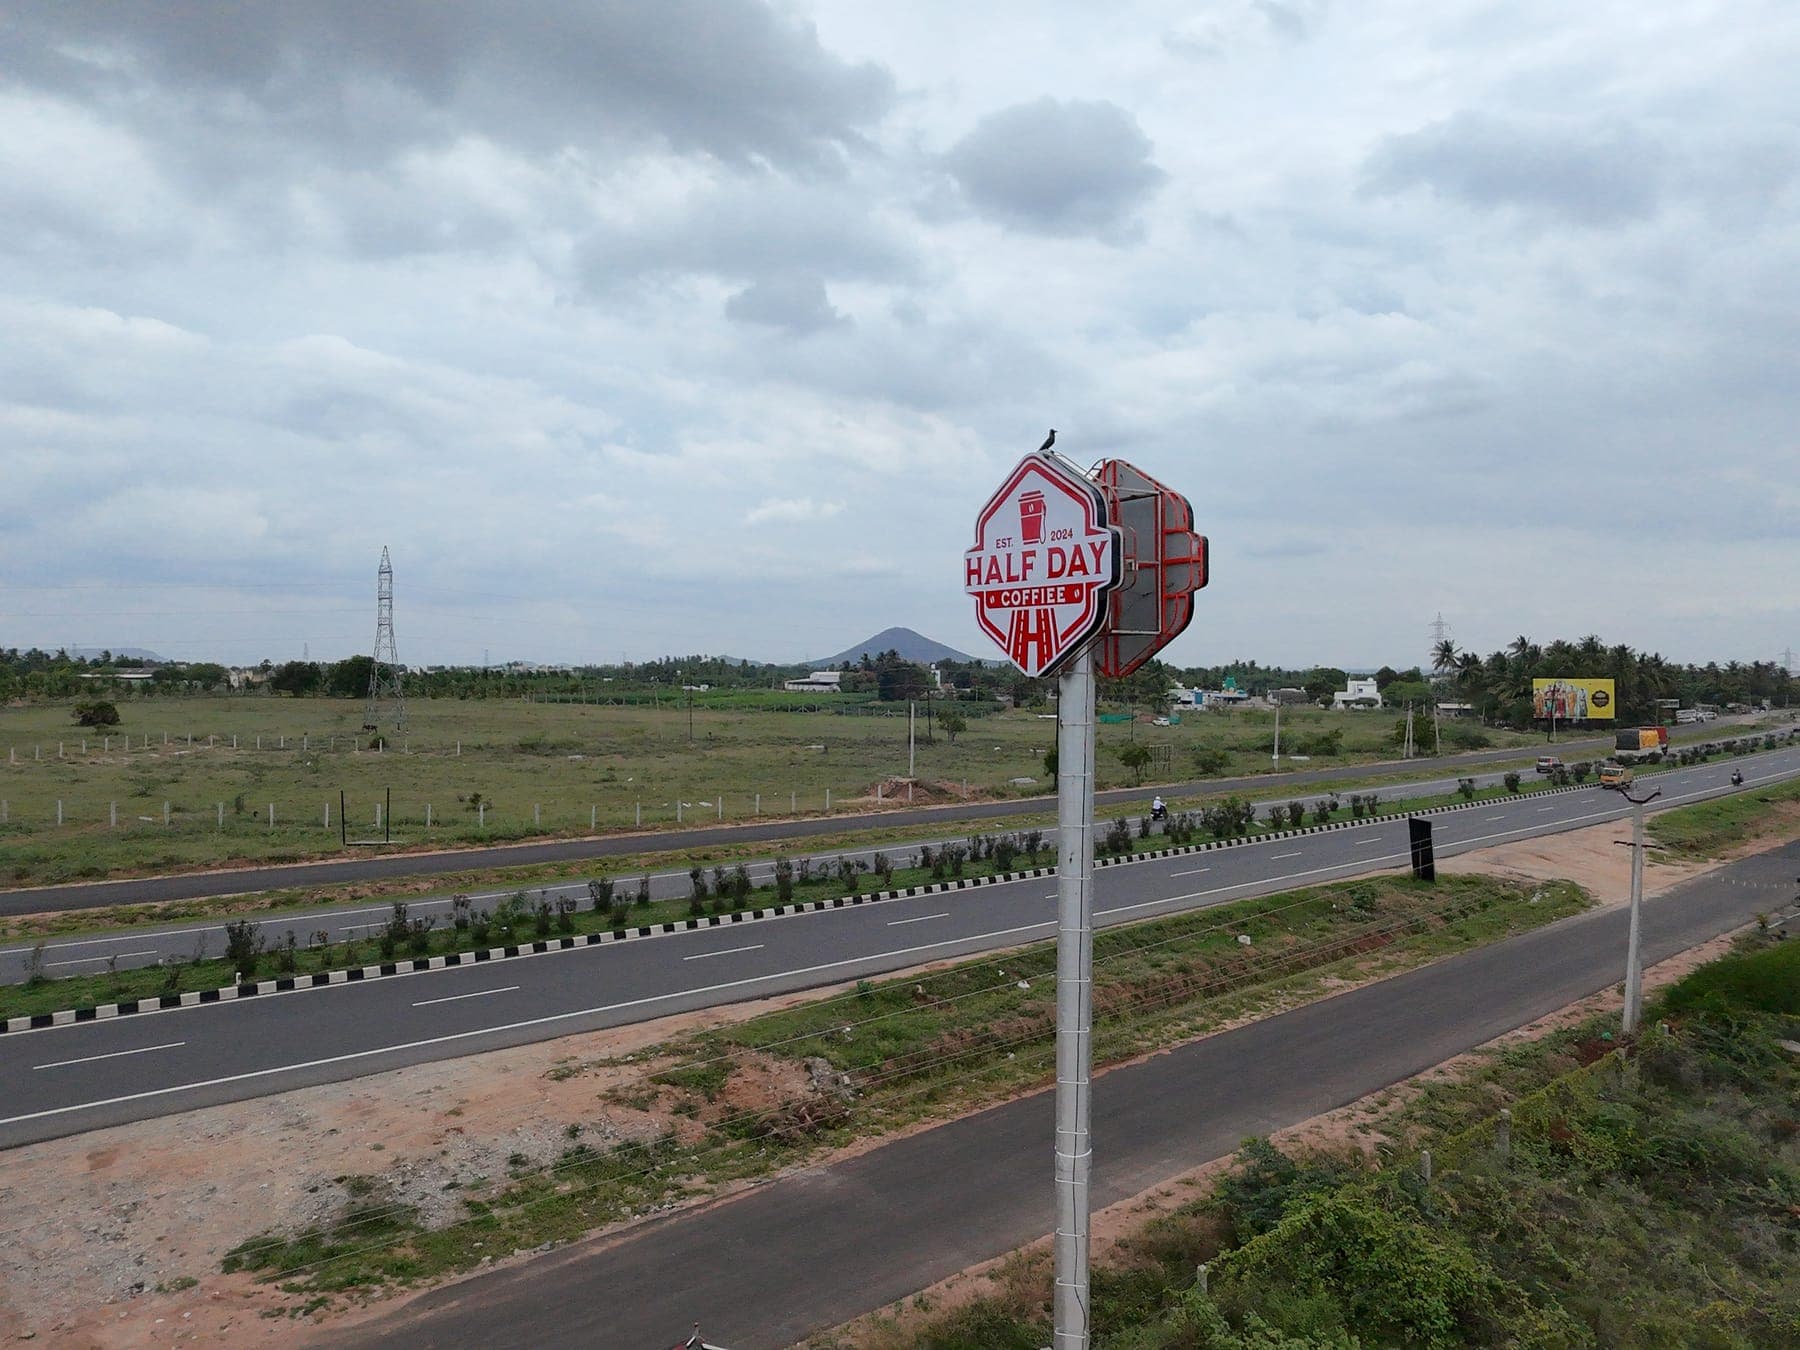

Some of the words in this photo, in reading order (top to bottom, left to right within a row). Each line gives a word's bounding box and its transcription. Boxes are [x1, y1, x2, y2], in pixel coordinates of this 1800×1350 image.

[996, 537, 1014, 549] EST.
[1050, 528, 1074, 541] 2024
[966, 550, 1037, 586] HALF
[1047, 540, 1109, 579] DAY
[1001, 587, 1066, 606] COFFIEE
